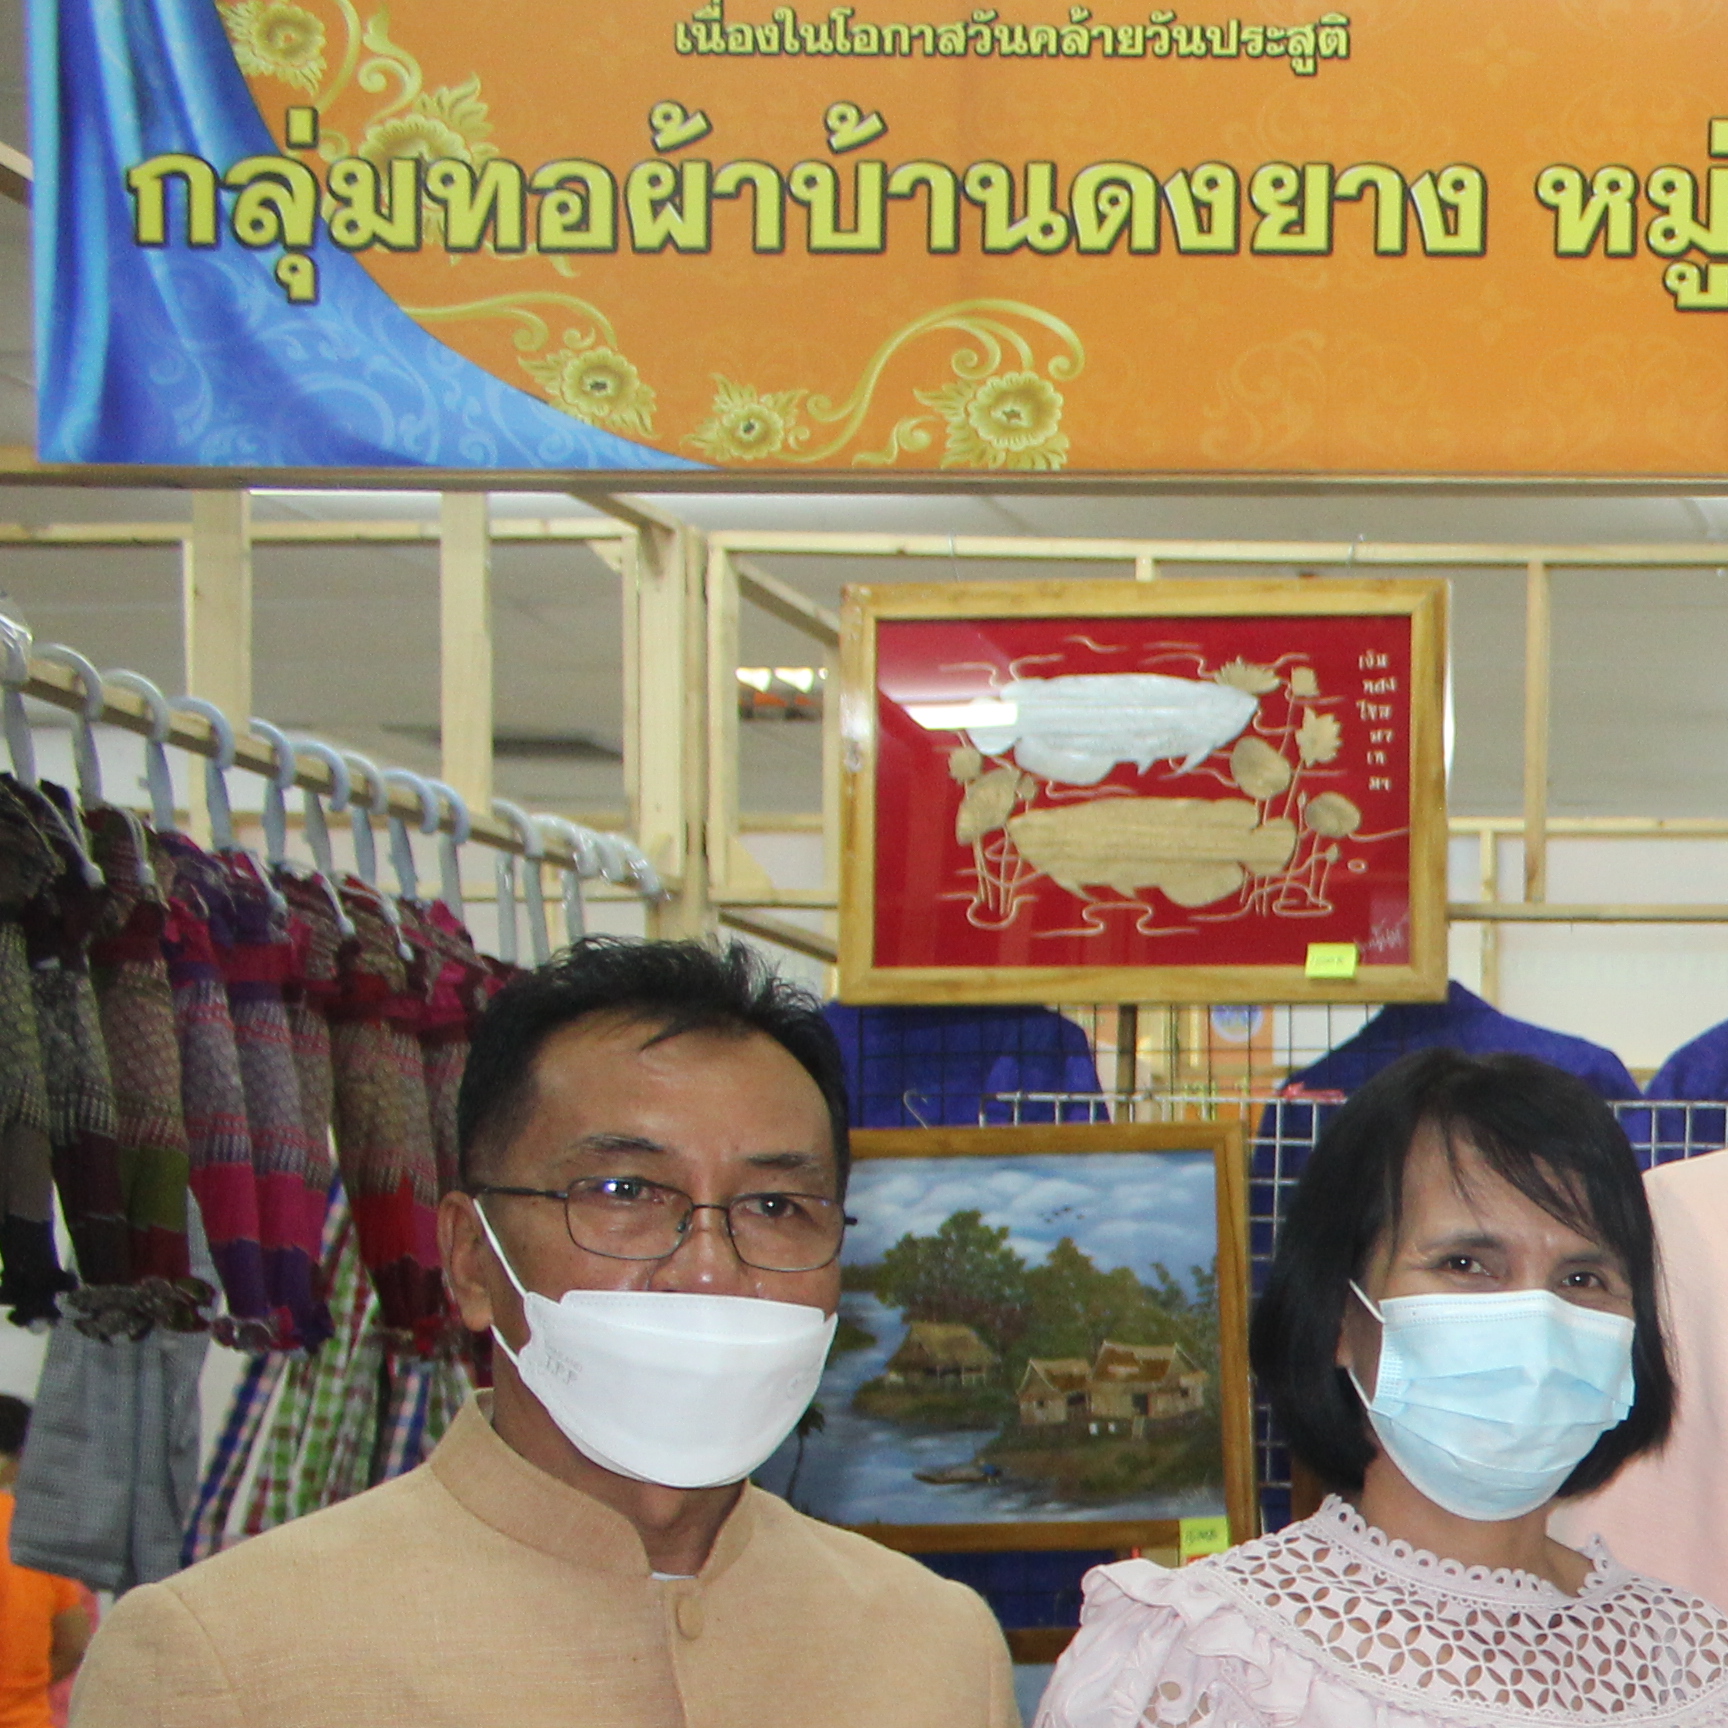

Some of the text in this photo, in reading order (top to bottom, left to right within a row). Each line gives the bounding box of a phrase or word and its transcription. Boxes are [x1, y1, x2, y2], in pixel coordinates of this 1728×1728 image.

[128, 101, 1487, 303] กลุ่มทอผ้าบ้านดงยาง
